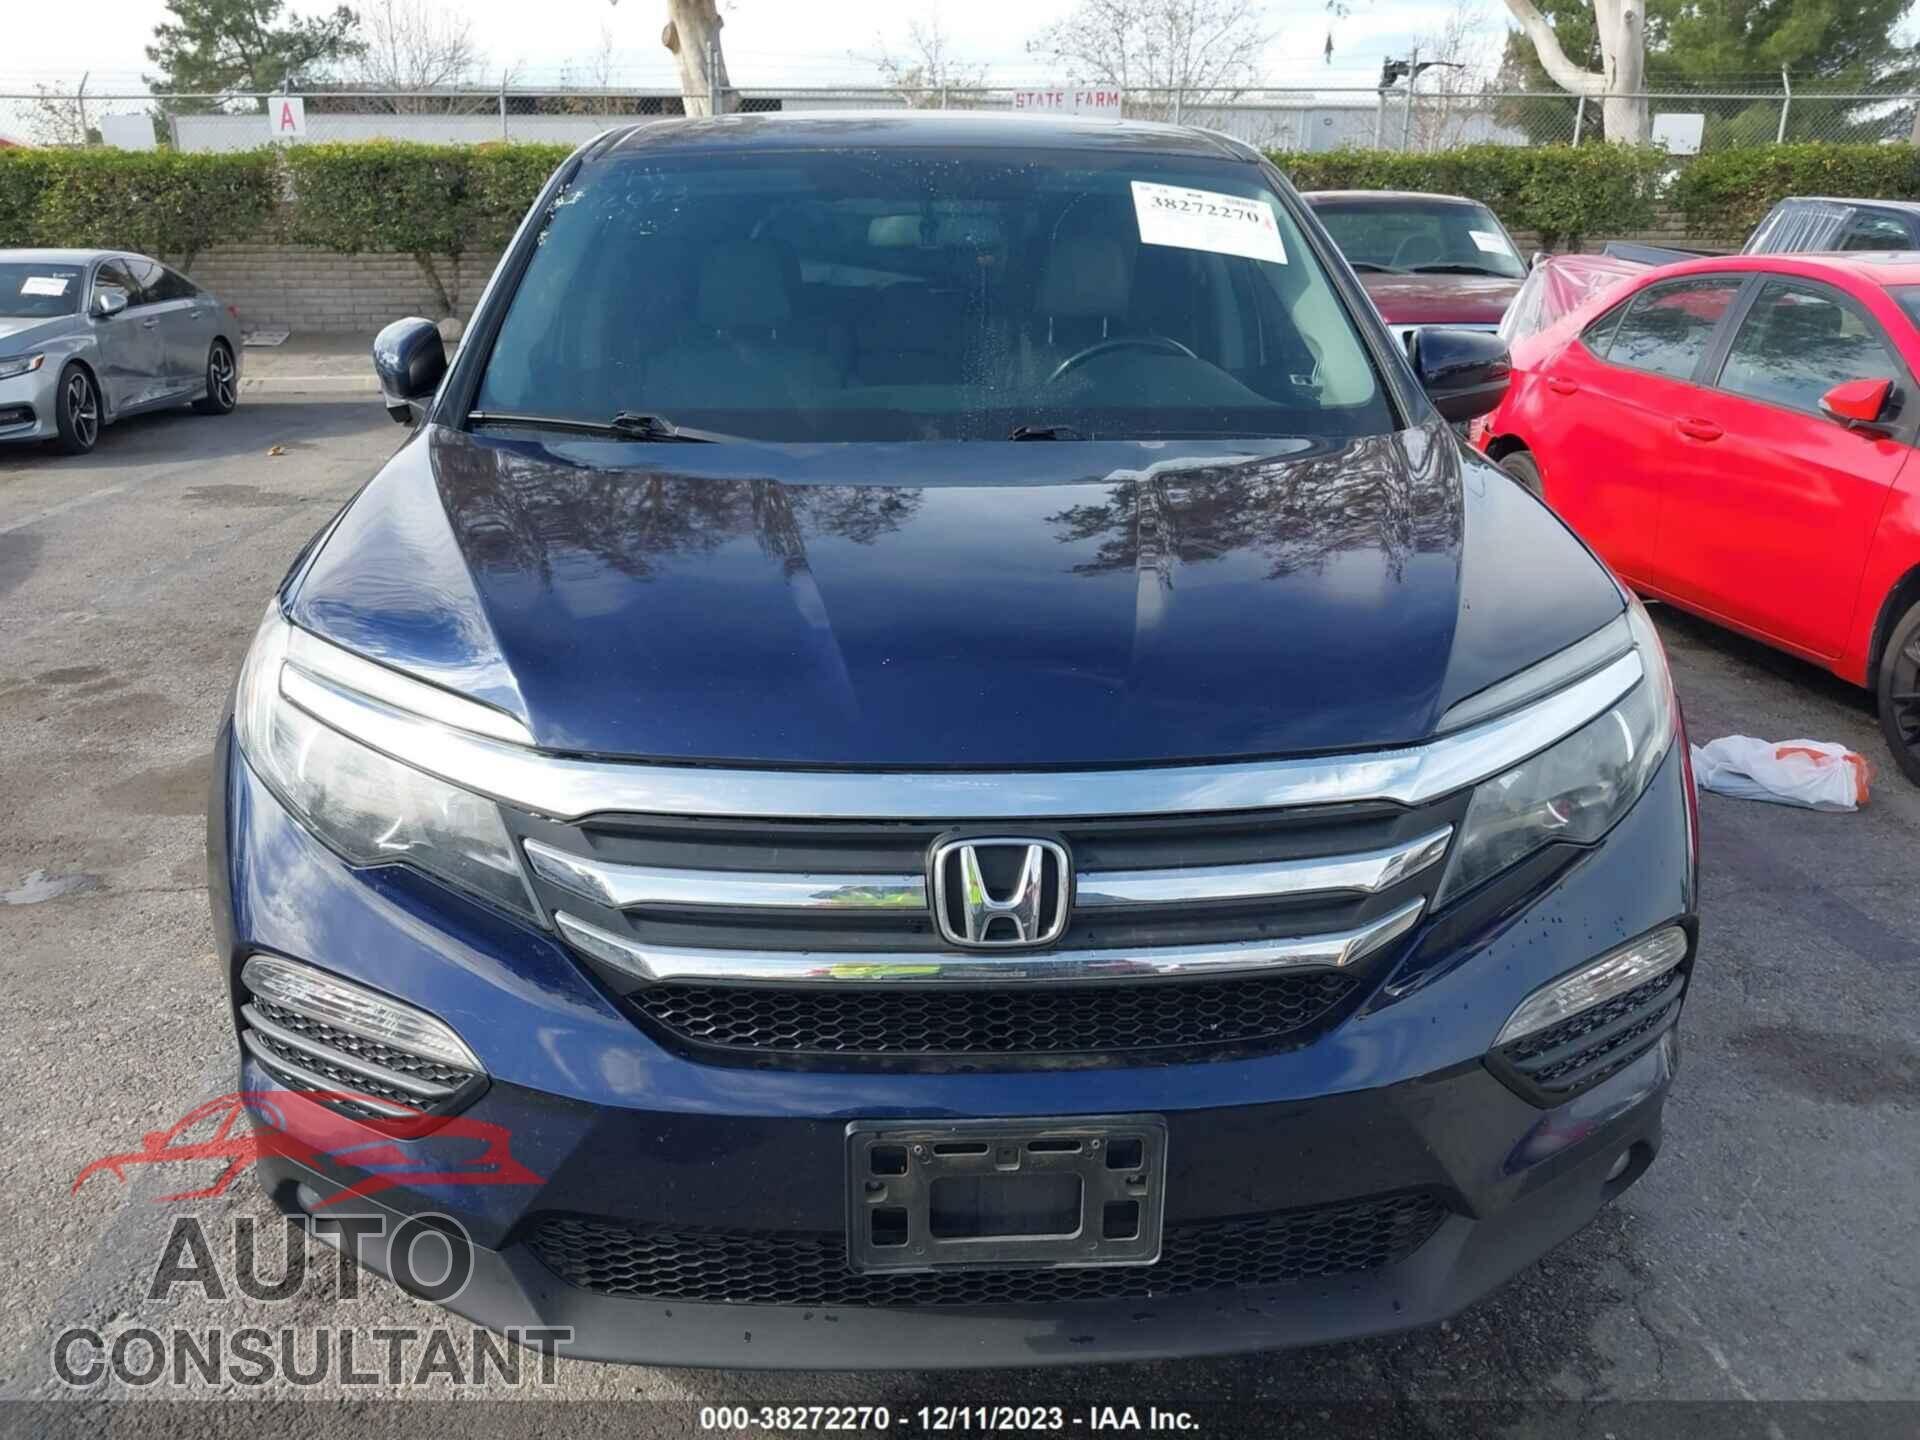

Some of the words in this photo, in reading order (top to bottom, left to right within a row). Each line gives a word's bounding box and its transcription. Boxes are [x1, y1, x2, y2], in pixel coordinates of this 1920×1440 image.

[1015, 92, 1064, 108] STATE
[1075, 91, 1119, 107] FARM
[281, 101, 296, 131] A
[1150, 195, 1260, 224] 38272270
